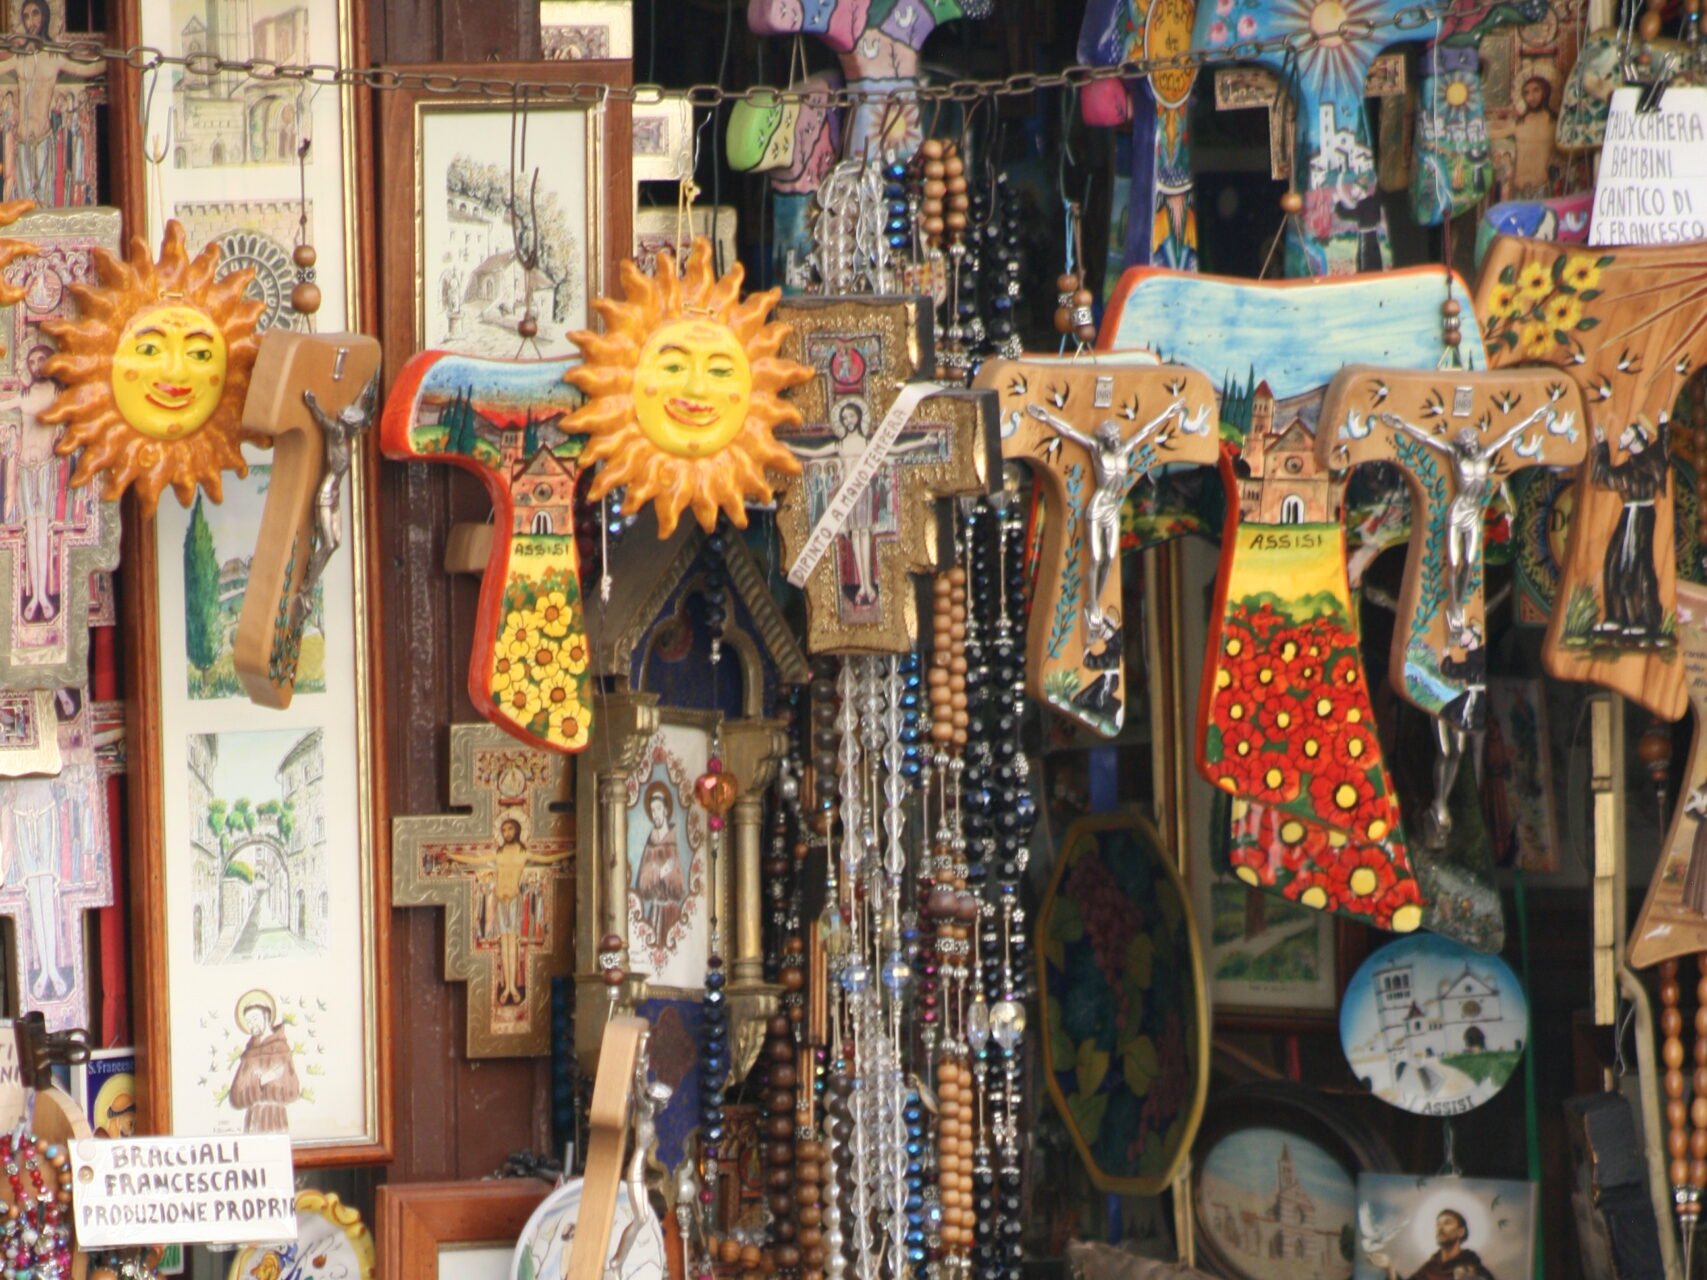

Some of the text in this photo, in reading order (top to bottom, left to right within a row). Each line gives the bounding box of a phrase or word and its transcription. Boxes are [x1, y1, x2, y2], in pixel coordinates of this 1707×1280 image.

[1611, 146, 1672, 179] BAMBINI
[1599, 186, 1693, 217] CANTICO DI
[1610, 219, 1705, 245] FRANCESCO
[793, 409, 907, 583] DIPINTO A MANO TEMPERA
[515, 542, 569, 556] ASSISI
[1249, 534, 1322, 550] ASSISI
[1422, 1095, 1474, 1115] ASSISI
[111, 1141, 240, 1169] BRACCIALI
[105, 1168, 267, 1197] FRANCESCANI
[82, 1201, 208, 1227] PRODUZIONE
